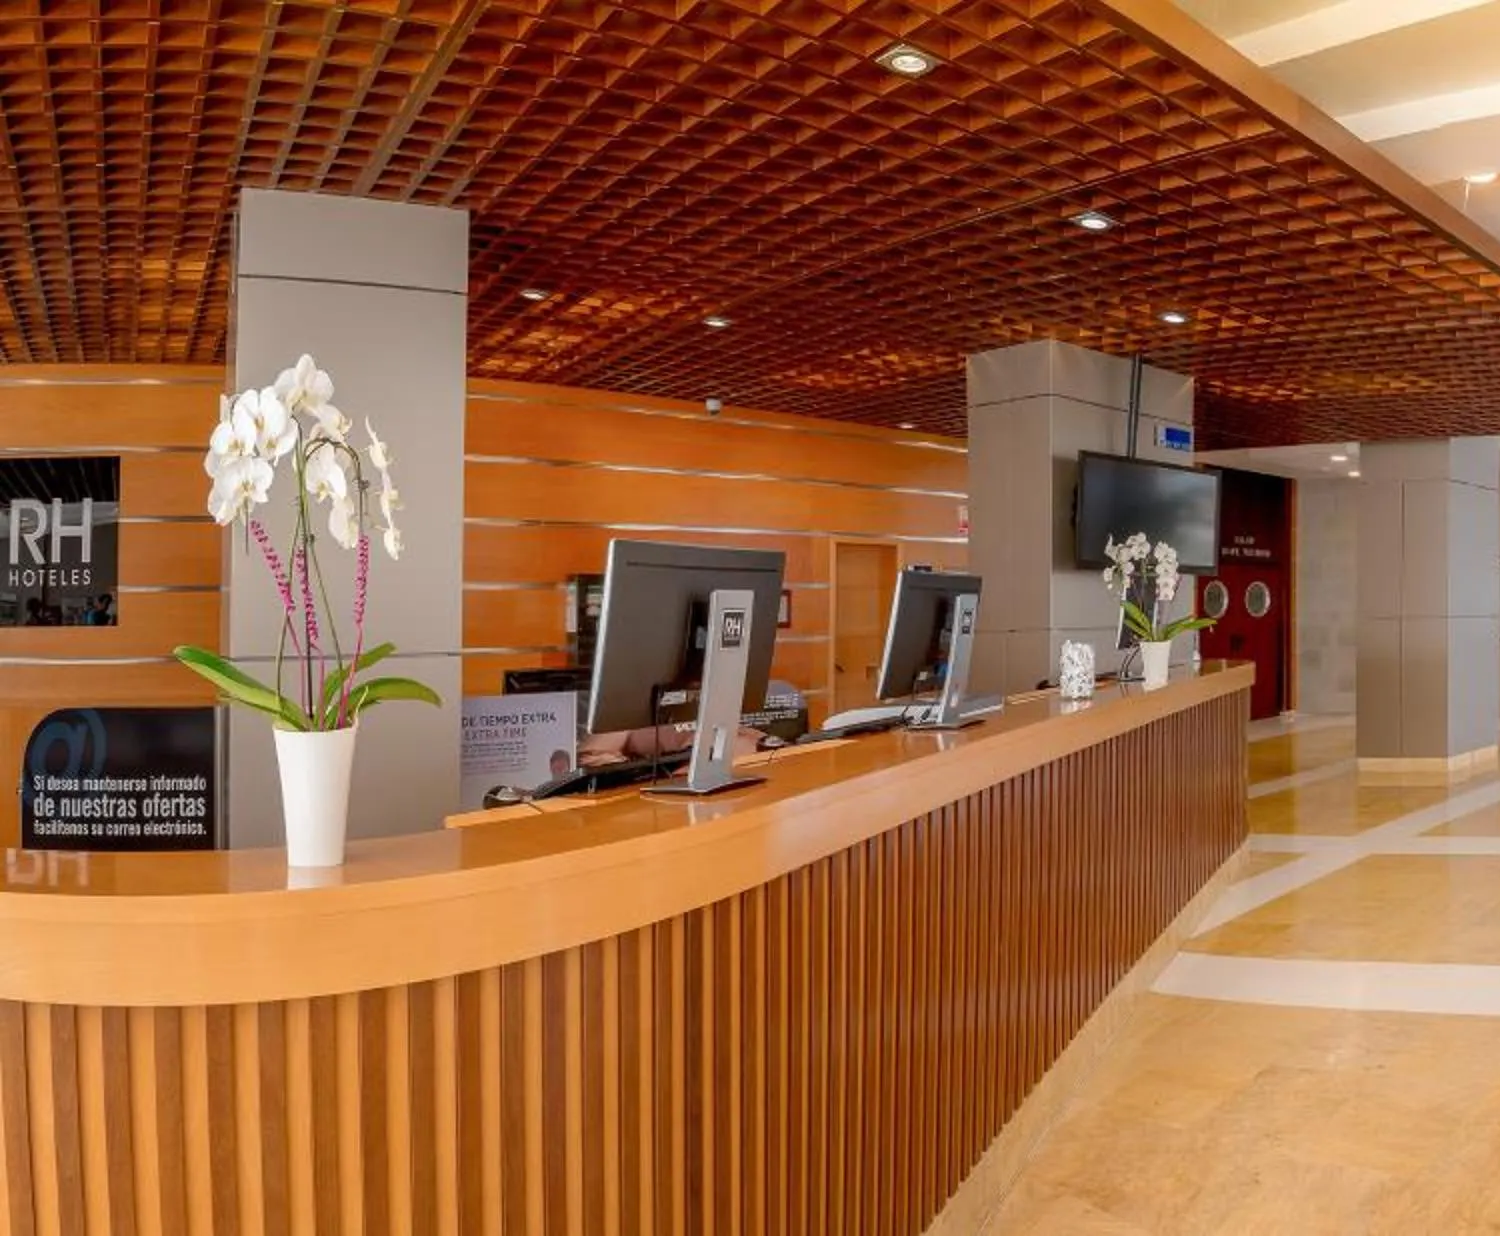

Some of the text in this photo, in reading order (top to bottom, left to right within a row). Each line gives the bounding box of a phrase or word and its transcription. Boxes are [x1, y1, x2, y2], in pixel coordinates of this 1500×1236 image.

[9, 497, 92, 564] RH
[8, 569, 91, 587] HOTELES
[521, 711, 557, 725] EXTRA
[33, 775, 207, 792] Si desea mantenerse informado
[33, 792, 206, 818] de nuestras ofertas
[91, 822, 103, 836] su
[106, 822, 141, 837] correo
